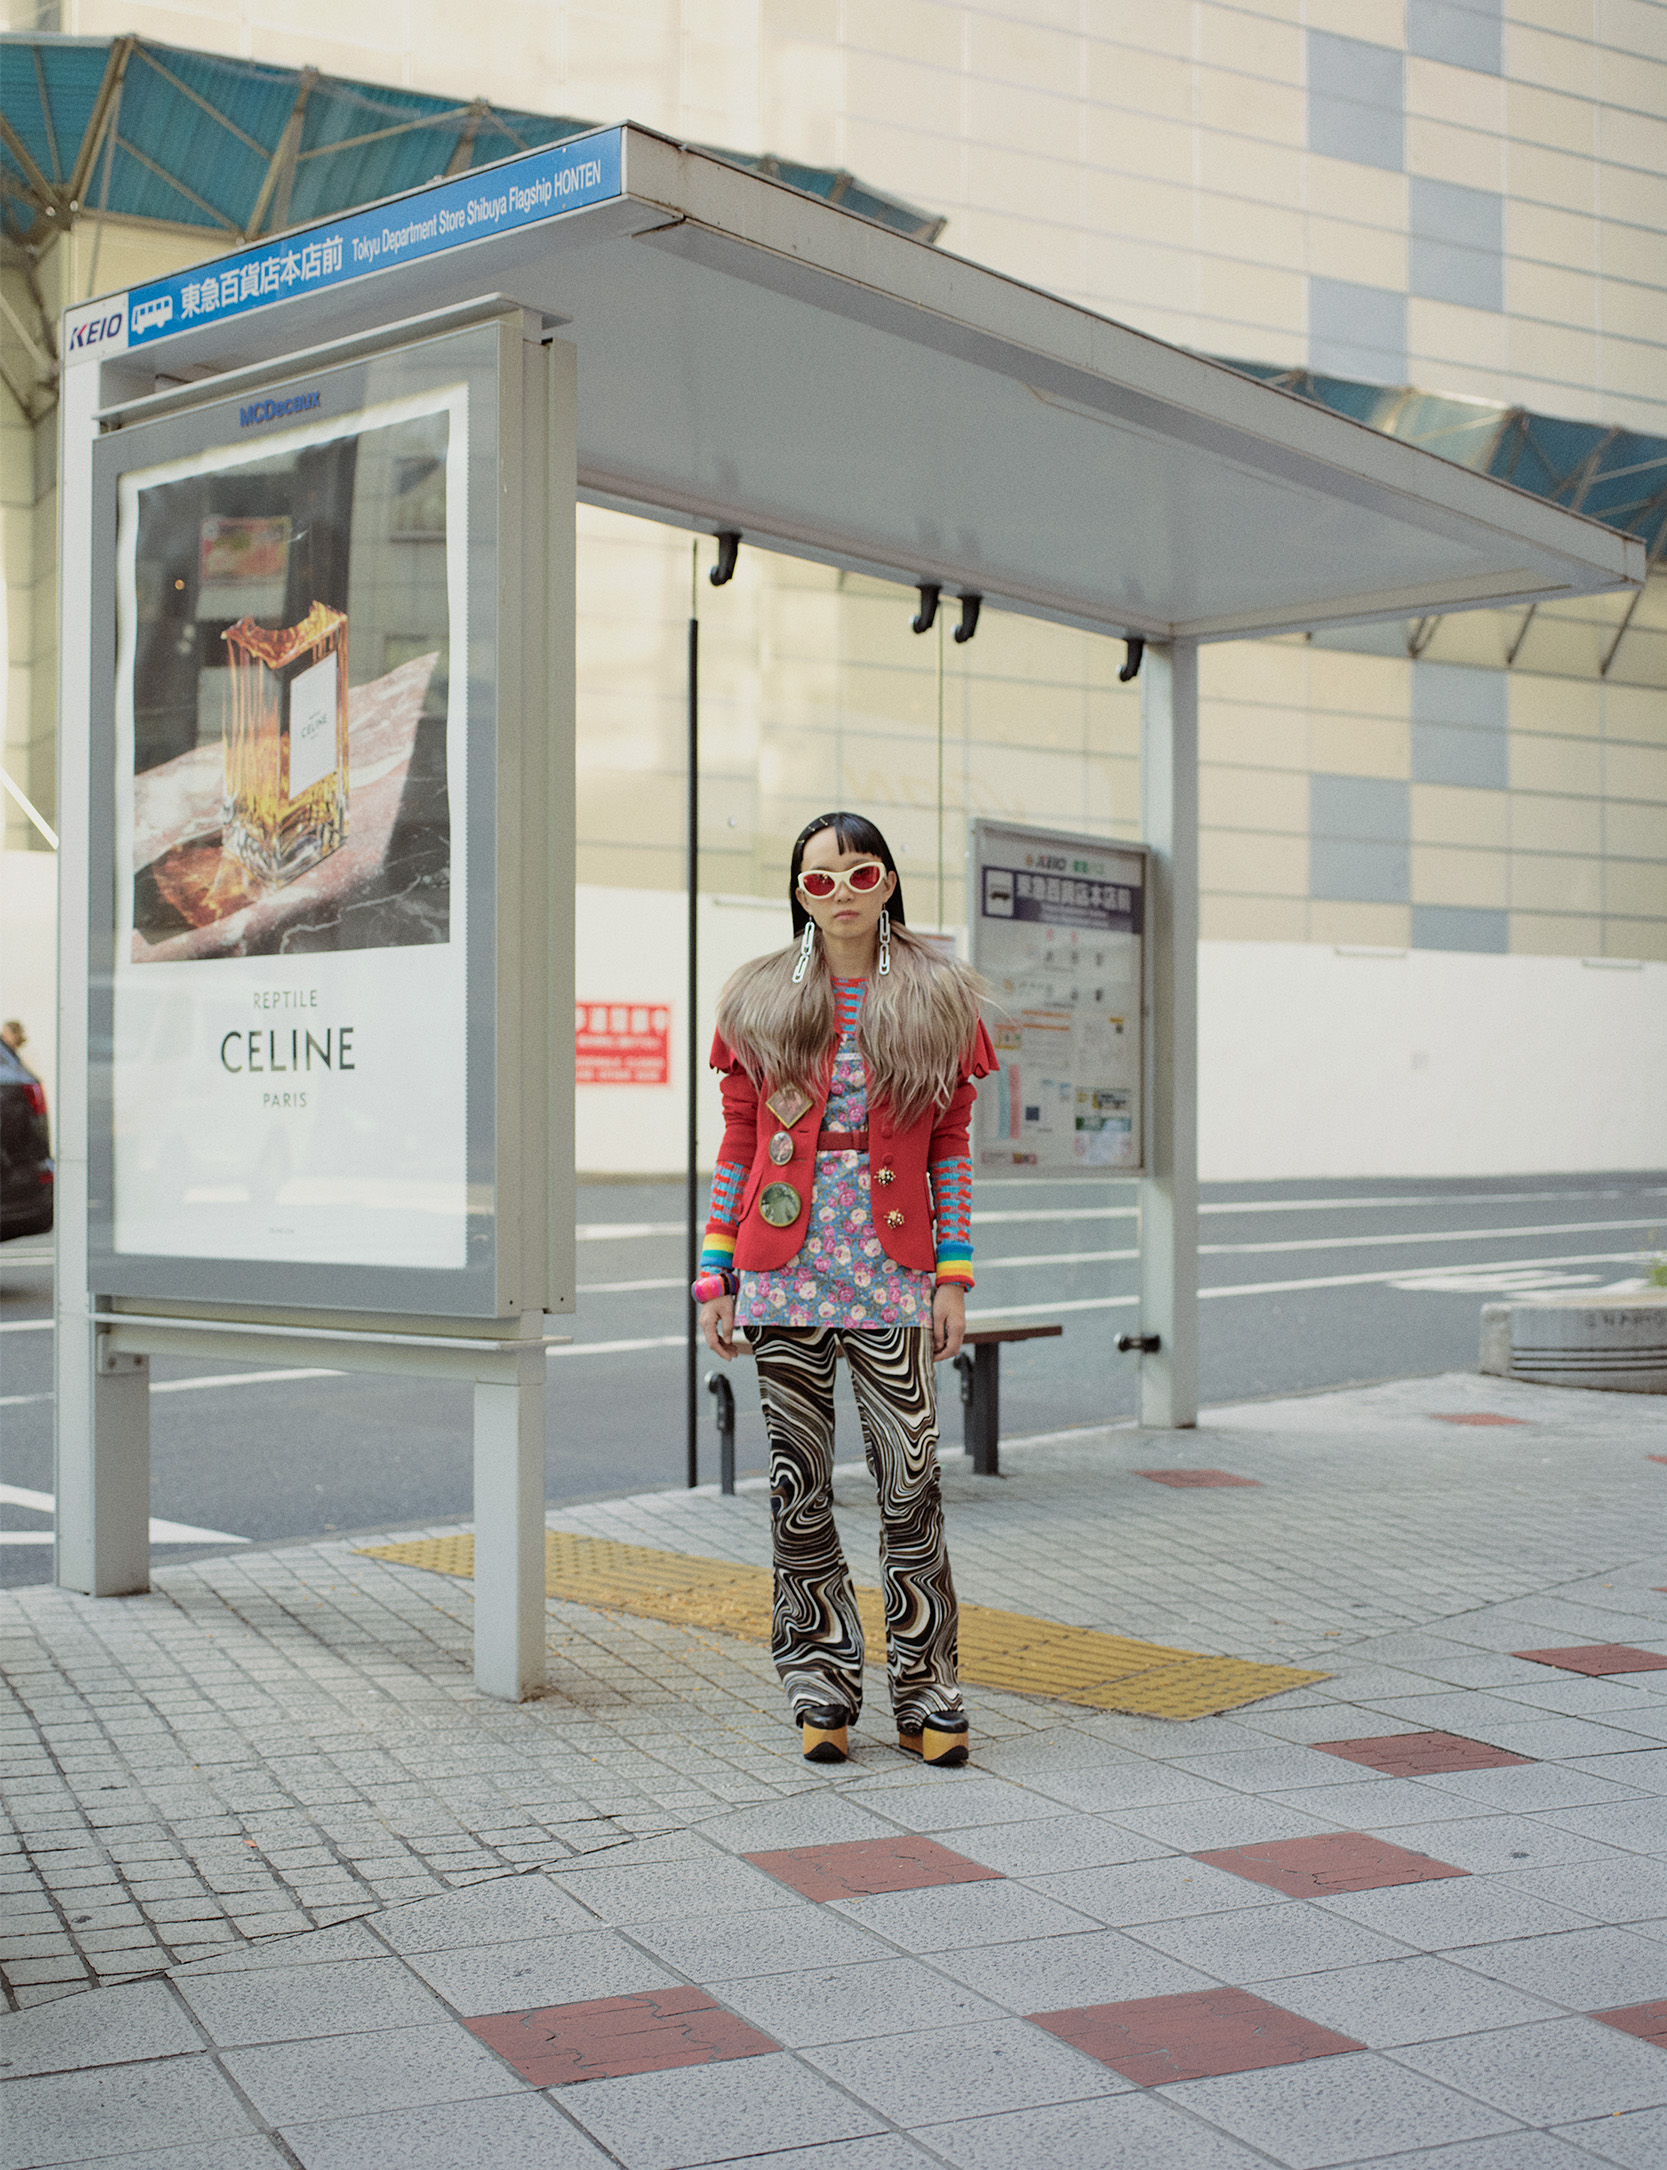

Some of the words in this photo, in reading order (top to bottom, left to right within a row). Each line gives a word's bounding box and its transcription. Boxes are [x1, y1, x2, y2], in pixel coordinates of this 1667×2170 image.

[352, 235, 381, 263] Tokyu
[382, 214, 437, 251] Department
[438, 207, 465, 234] Store
[467, 196, 507, 224] Shibuya
[509, 179, 552, 213] Flagship
[554, 159, 601, 195] HONTEN
[180, 235, 344, 321] 東急百貨店本店前
[69, 313, 123, 350] KEIO
[240, 390, 320, 428] MCDecaux
[253, 989, 318, 1009] REPTILE
[220, 1027, 356, 1074] CELINE
[263, 1092, 308, 1109] PARIS
